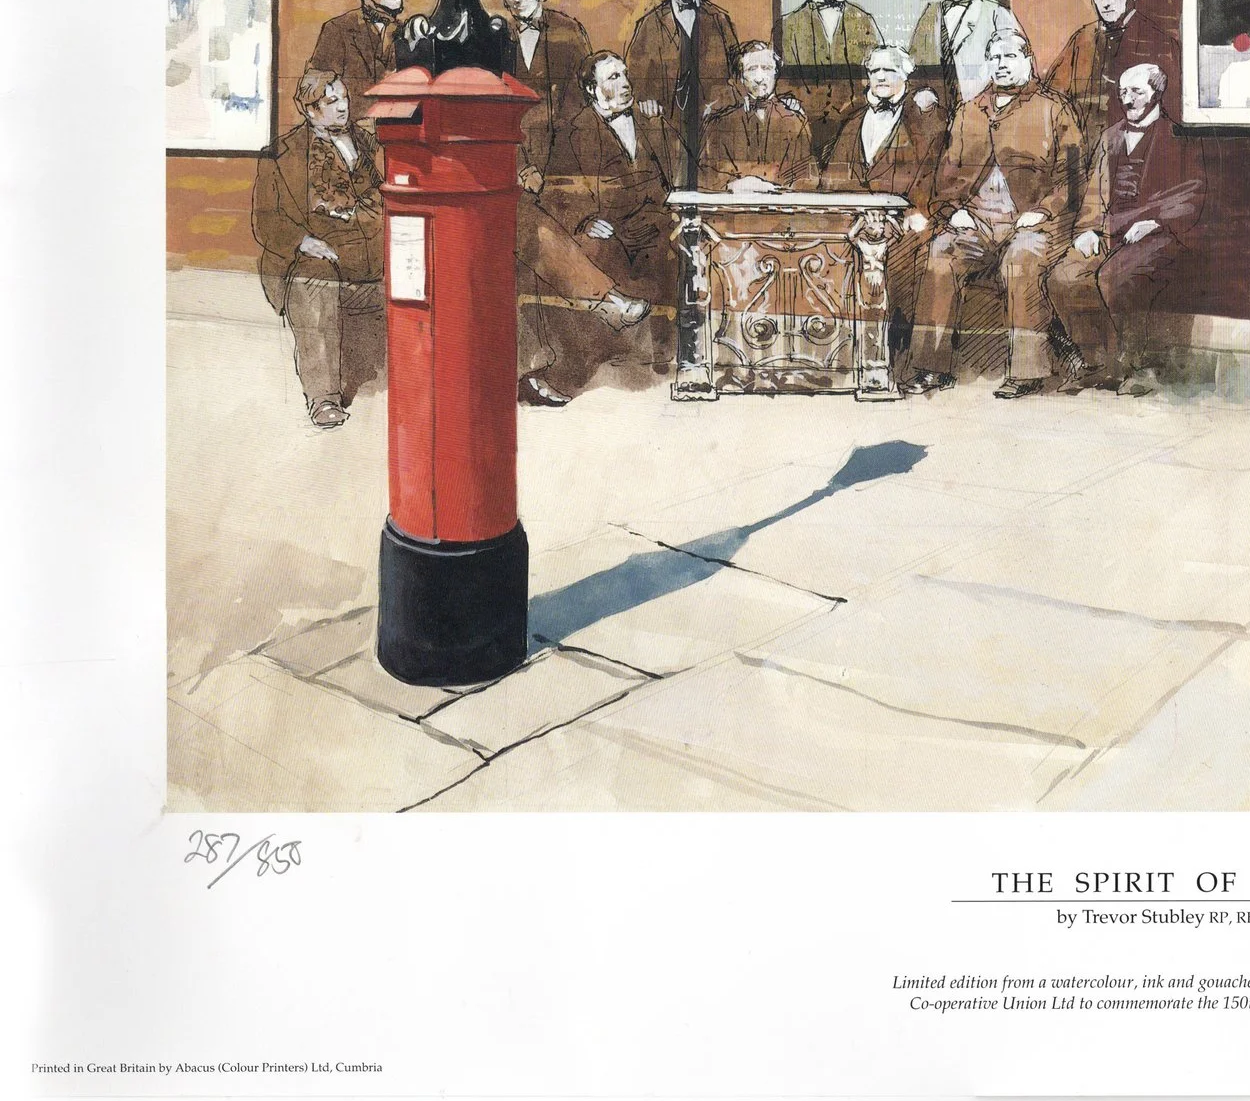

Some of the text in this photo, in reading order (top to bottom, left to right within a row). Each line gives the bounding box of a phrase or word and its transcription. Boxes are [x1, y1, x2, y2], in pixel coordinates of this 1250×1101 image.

[991, 872, 1053, 894] THE
[1075, 871, 1175, 894] SPIRIT
[1196, 871, 1237, 893] OF
[1056, 908, 1078, 929] by
[1081, 909, 1138, 925] Trevor
[1141, 908, 1205, 929] Stubley
[1209, 911, 1233, 928] RP,
[892, 974, 946, 990] Limited
[949, 974, 998, 989] edition
[1000, 974, 1035, 994] from
[1038, 978, 1047, 989] a
[1050, 974, 1139, 991] watercolour,
[1142, 974, 1165, 989] ink
[1167, 974, 1195, 989] and
[909, 996, 999, 1015] Co-operative
[1003, 996, 1047, 1011] Union
[1051, 995, 1076, 1010] Ltd
[1079, 997, 1093, 1010] to
[1096, 996, 1194, 1010] commemorate
[1197, 995, 1219, 1010] the
[31, 1061, 383, 1076] Printed in Great Britain by Abacus (Colour Printers) Ltd, Cumbria
